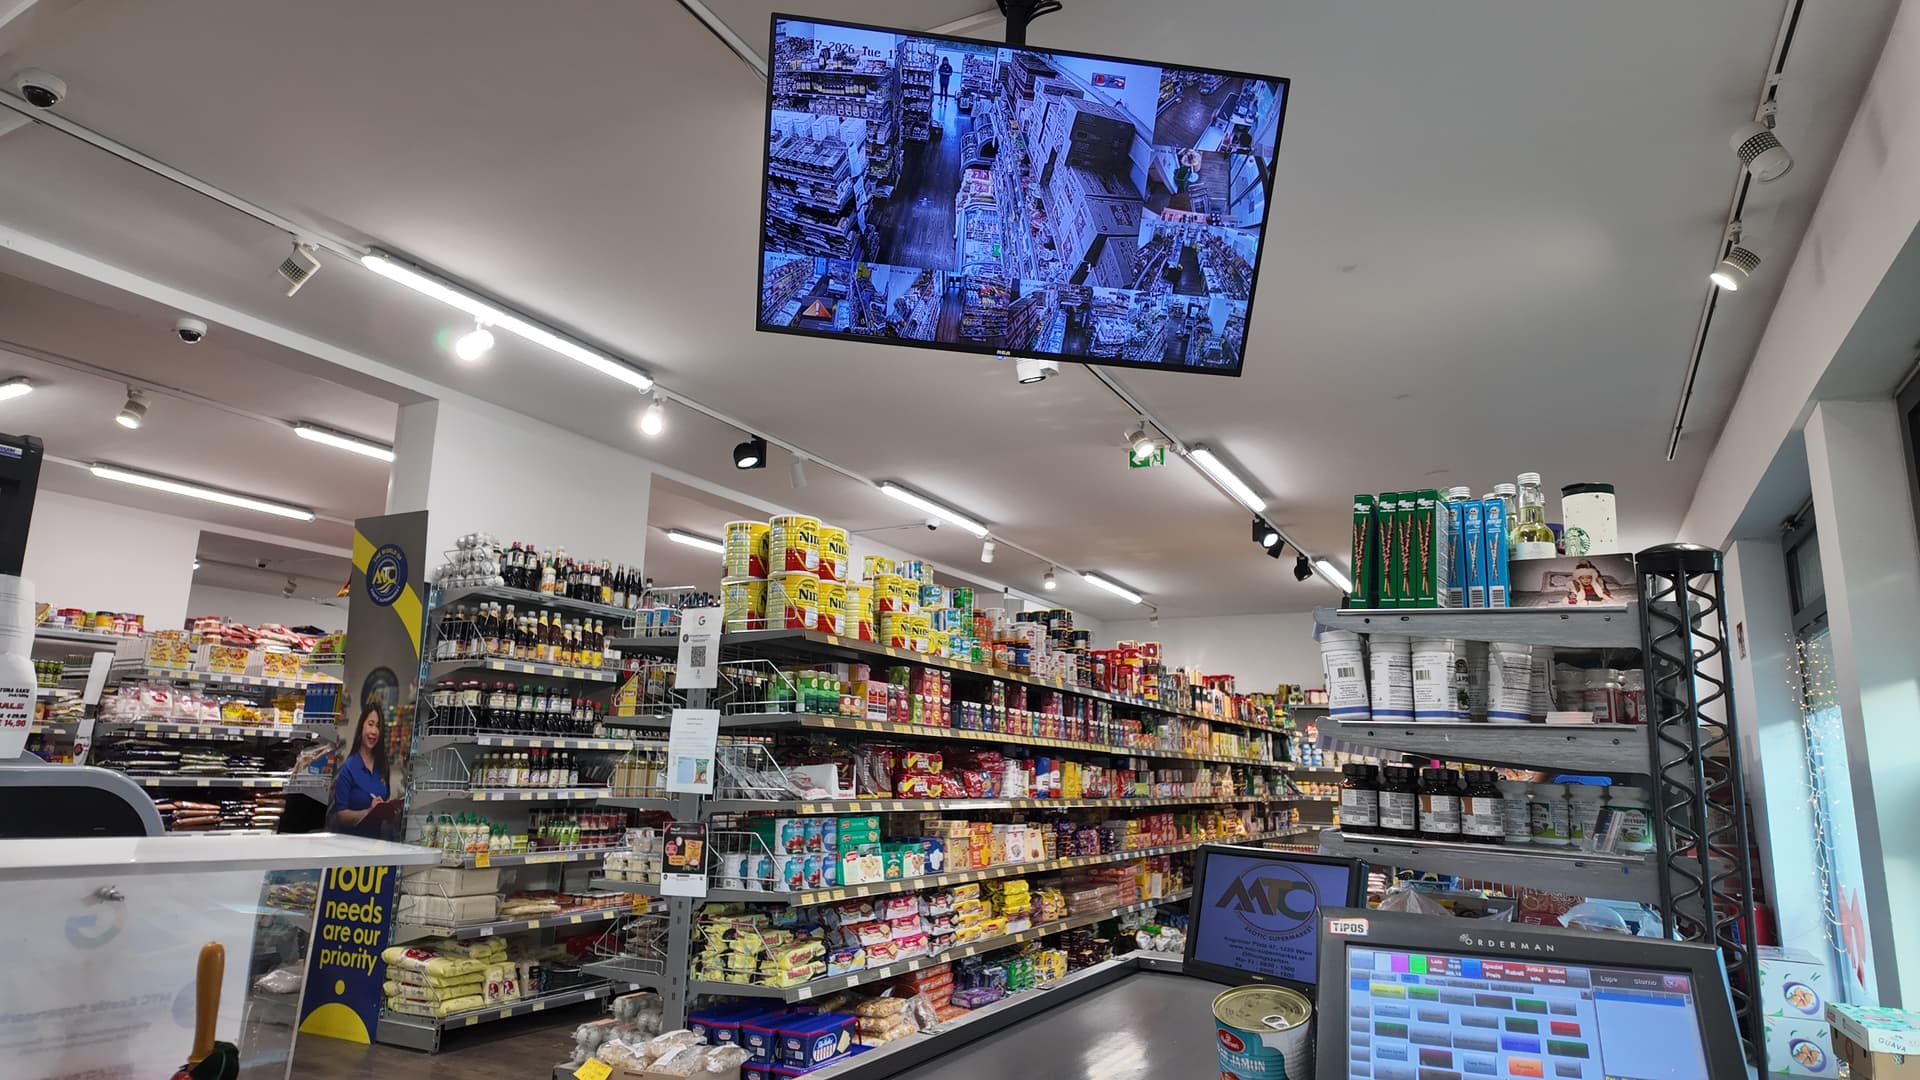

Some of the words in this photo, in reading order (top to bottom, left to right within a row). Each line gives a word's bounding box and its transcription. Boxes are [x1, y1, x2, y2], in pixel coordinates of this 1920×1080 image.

[325, 896, 383, 925] needs
[1215, 876, 1315, 921] MTC
[323, 923, 352, 943] are
[353, 926, 381, 947] our
[1464, 936, 1556, 952] ORDERMAN
[319, 945, 378, 977] priority
[1878, 1036, 1907, 1053] GUAVA
